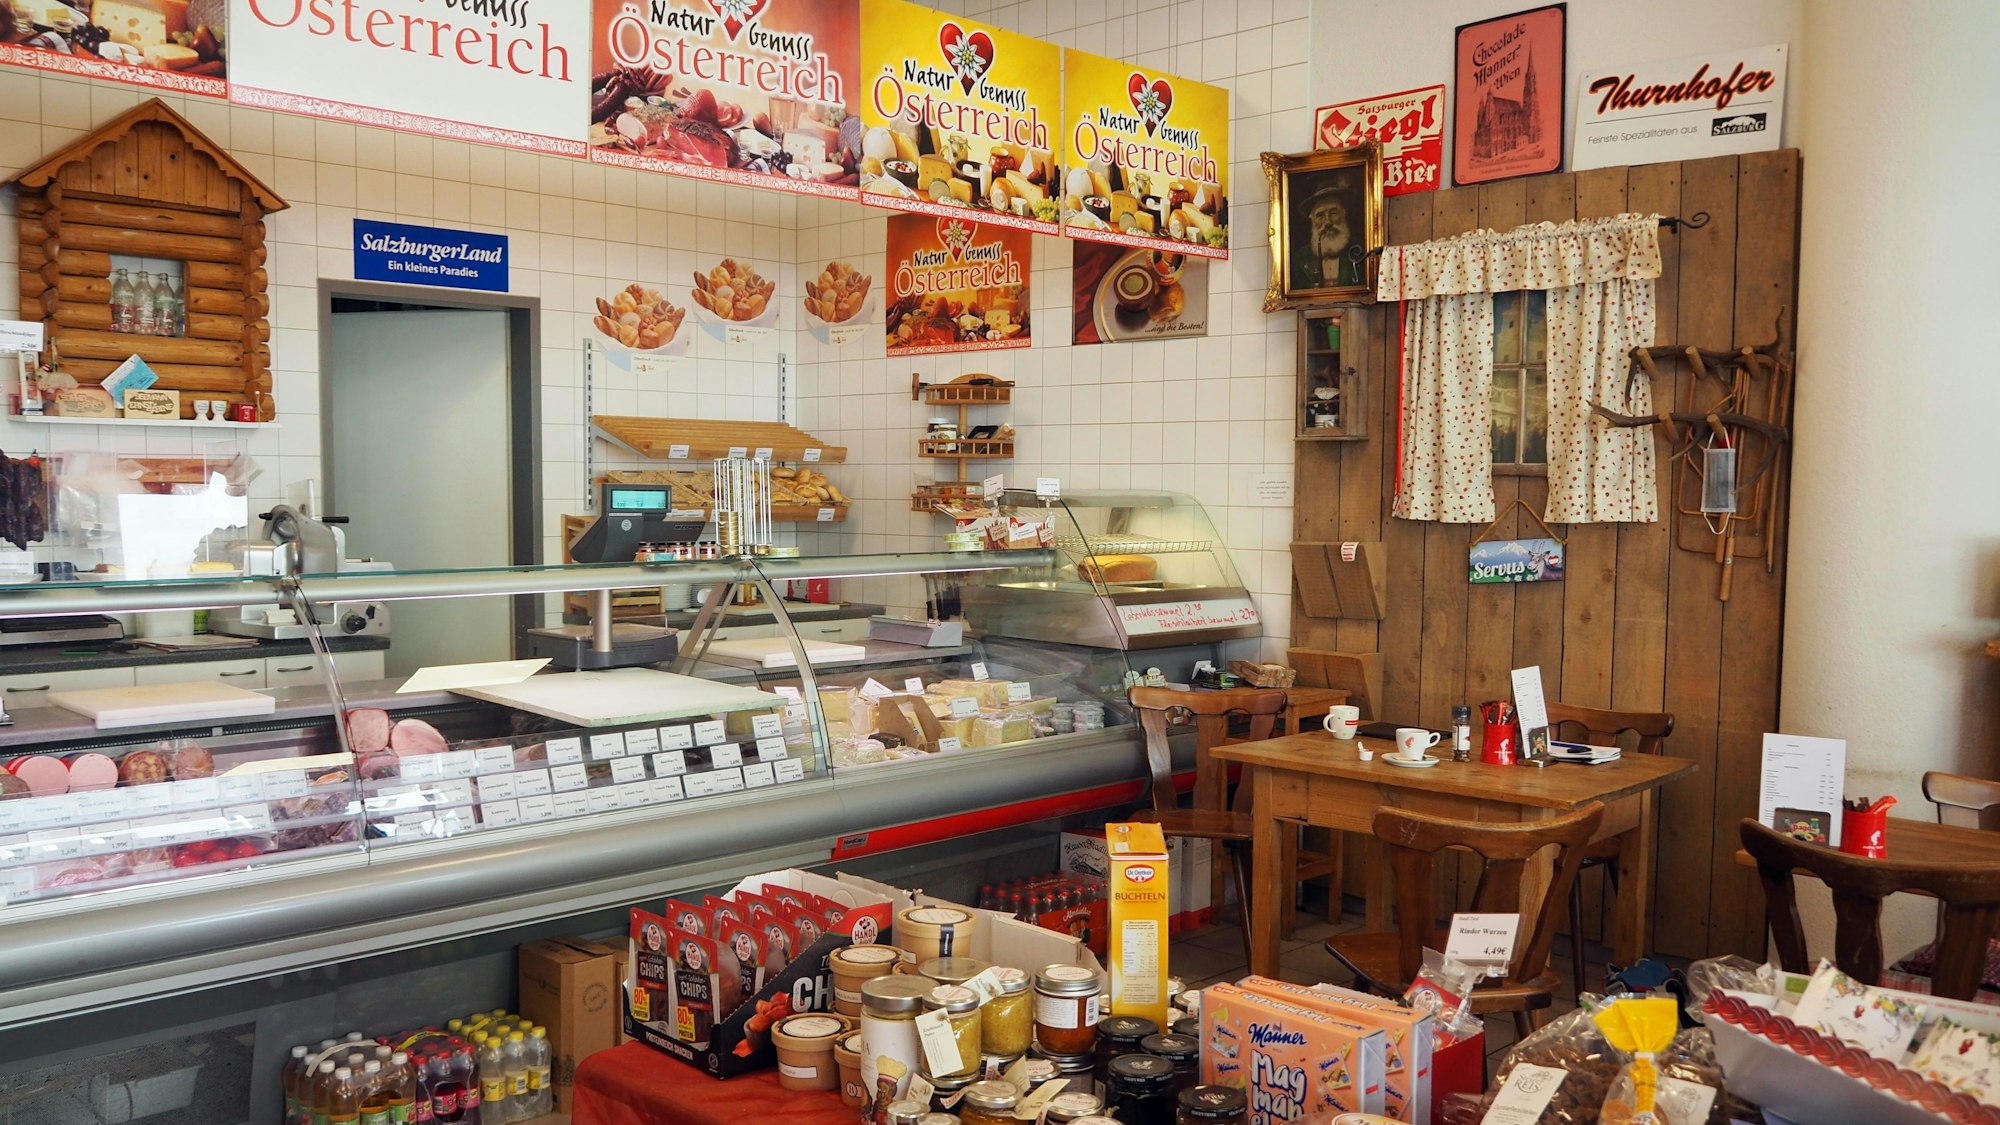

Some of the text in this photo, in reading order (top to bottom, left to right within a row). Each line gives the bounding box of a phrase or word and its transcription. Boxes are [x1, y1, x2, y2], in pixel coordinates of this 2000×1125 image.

[651, 0, 811, 61] Natur Genuss
[611, 6, 843, 104] Österreich
[1472, 23, 1527, 67] Chocolade
[904, 60, 1026, 112] Natur Genuss
[1493, 67, 1521, 91] Wien
[1588, 61, 1775, 115] Thurnhofer
[873, 67, 1049, 151] Österreich
[1357, 99, 1416, 115] Salzburger
[1099, 107, 1199, 150] Natur Genuss
[1588, 126, 1698, 145] Feinste Spezialitäten aus
[1075, 114, 1218, 184] Österreich
[1383, 157, 1437, 187] Bier
[360, 233, 502, 264] SalzburgerLand
[914, 243, 1001, 268] Natur Genuss
[388, 260, 479, 278] Ein kleines Paradies
[895, 254, 1021, 295] Österreich
[1166, 321, 1177, 332] die
[1473, 560, 1526, 580] Servus
[1115, 892, 1166, 901] BUCHTELN
[854, 927, 877, 940] HANDL
[1483, 947, 1508, 956] 4,49€
[640, 961, 665, 980] CHIPS
[680, 981, 708, 1000] CHIPS
[1215, 1024, 1238, 1041] Manner
[1248, 1022, 1308, 1048] Manner
[1217, 1063, 1240, 1074] Manner
[1251, 1050, 1306, 1102] Mag
[1319, 1056, 1340, 1072] Manner
[1514, 1079, 1540, 1090] REIS
